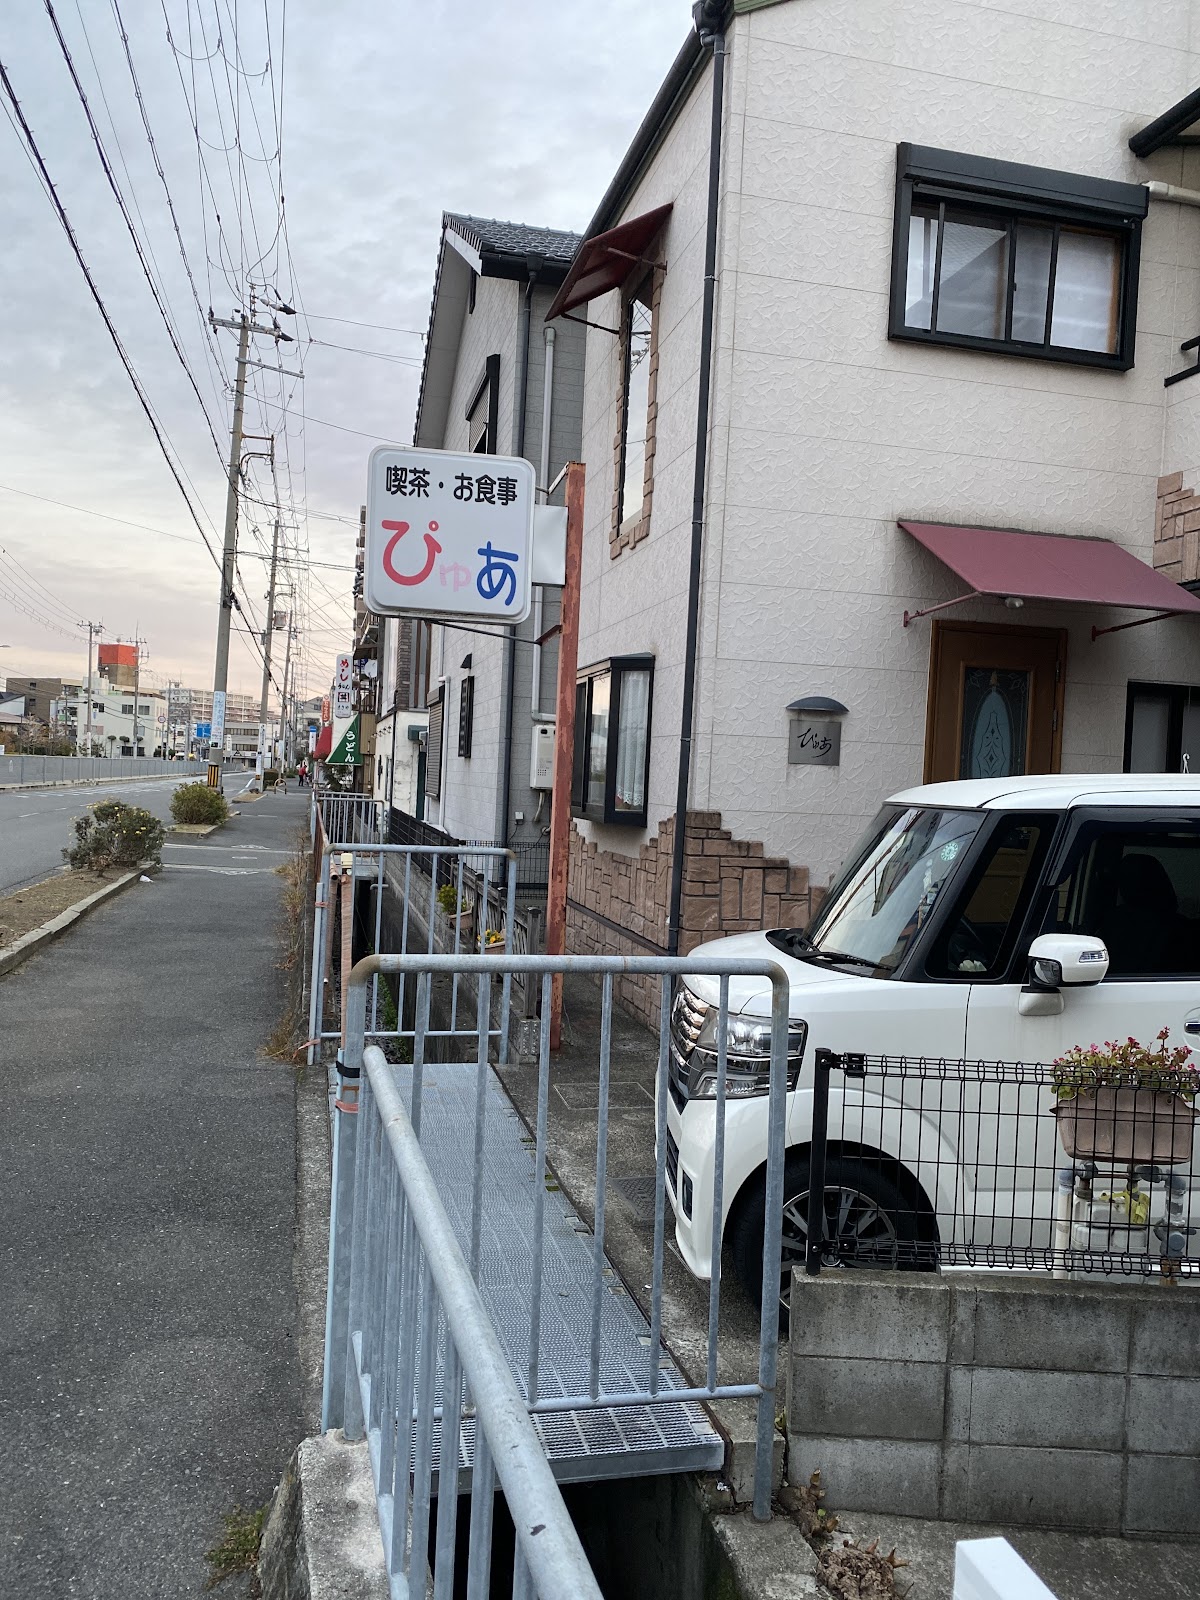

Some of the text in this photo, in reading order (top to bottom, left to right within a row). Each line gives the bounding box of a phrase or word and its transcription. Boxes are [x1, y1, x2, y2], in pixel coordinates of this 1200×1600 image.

[386, 465, 518, 506] 喫茶・お食事
[345, 731, 356, 762] うどん
